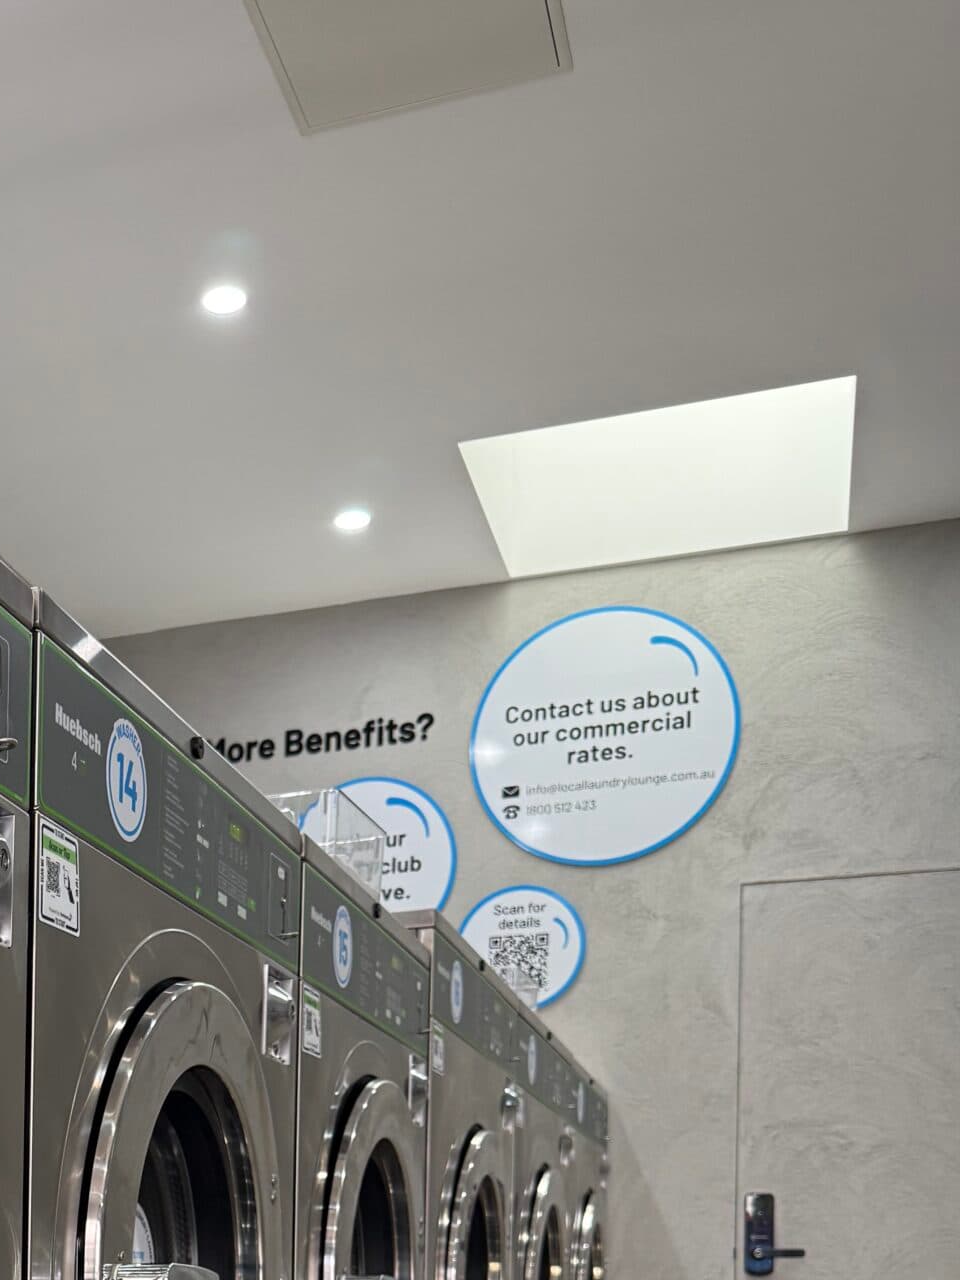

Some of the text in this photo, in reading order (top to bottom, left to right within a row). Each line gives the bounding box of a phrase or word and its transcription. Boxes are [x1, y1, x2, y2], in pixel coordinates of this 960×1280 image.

[505, 687, 700, 724] Contact us about
[55, 702, 101, 756] Huebsch
[284, 712, 435, 758] Benefits?
[513, 711, 692, 746] our commercial
[116, 723, 141, 758] WASHER
[72, 752, 78, 770] 4
[567, 745, 633, 765] rates.
[117, 753, 138, 813] 14
[526, 770, 715, 796] info@locallaundrylounge.com.au
[385, 834, 407, 848] ur
[382, 856, 422, 875] club
[382, 887, 410, 901] ve.
[494, 902, 546, 916] Scan for
[499, 917, 541, 929] details
